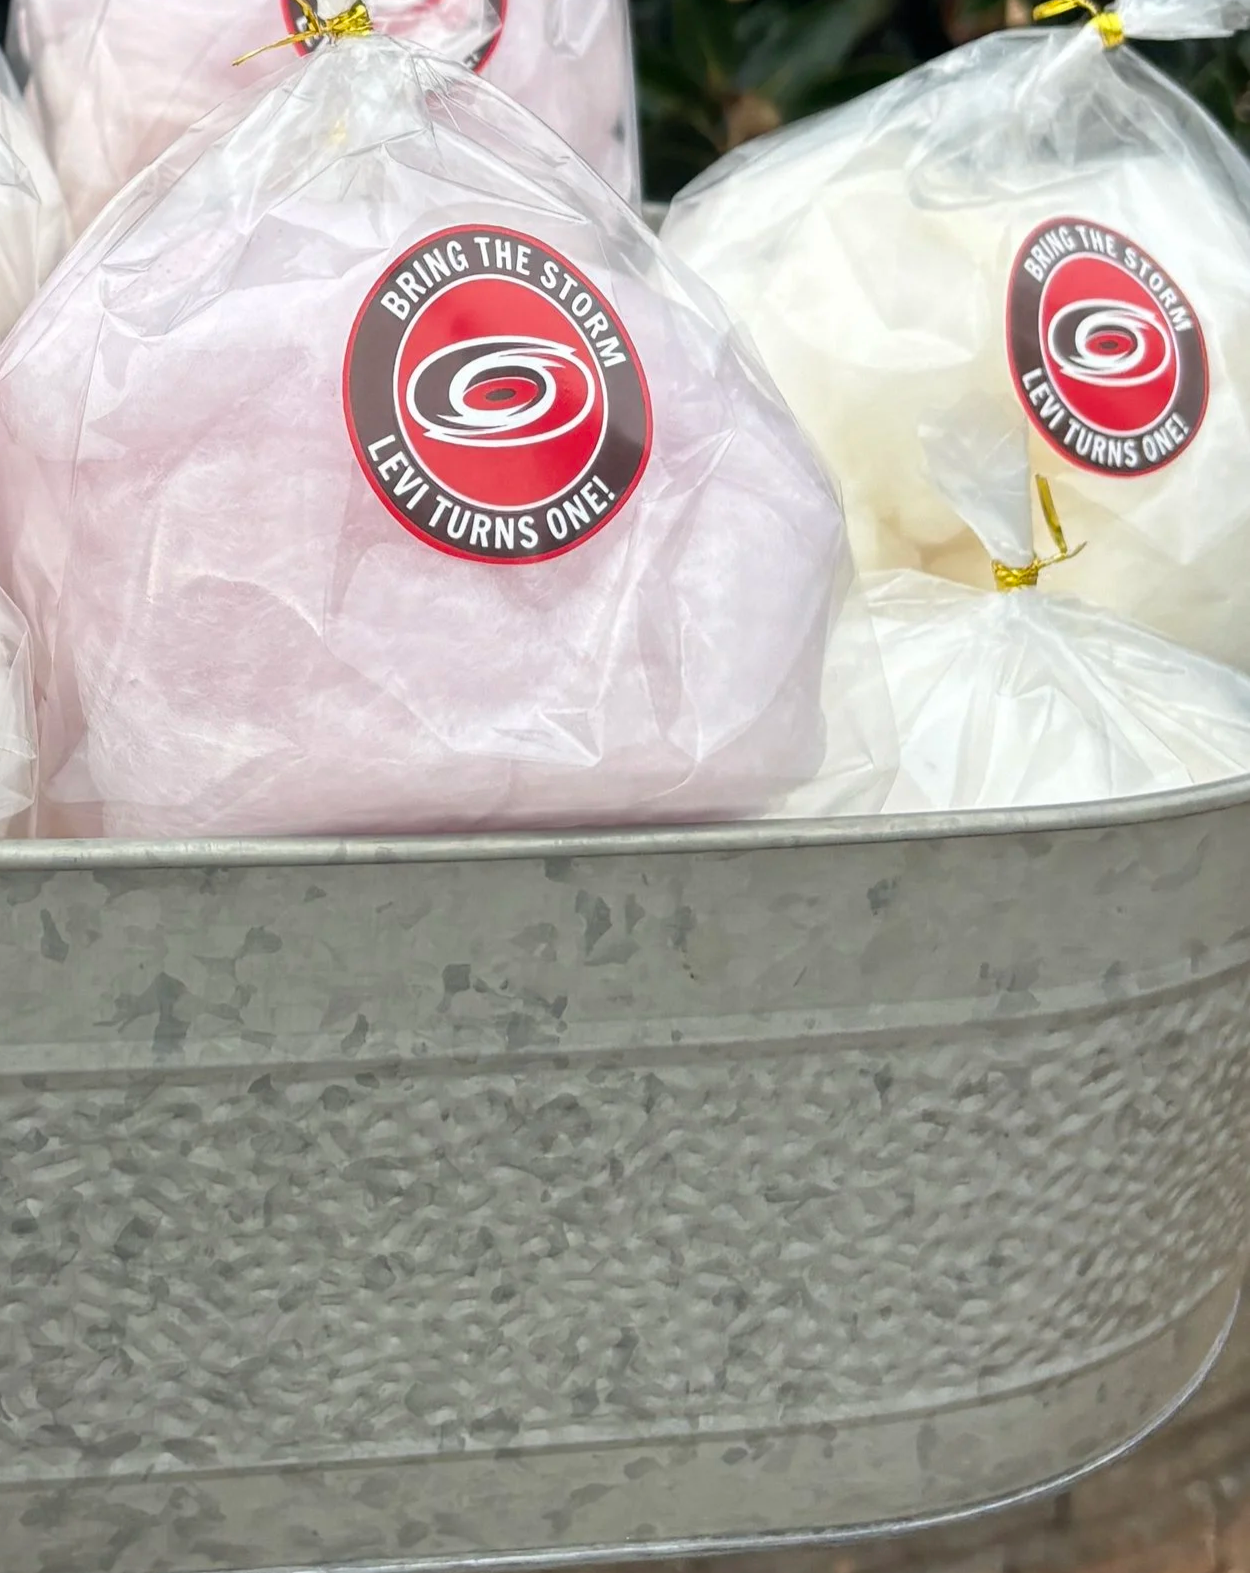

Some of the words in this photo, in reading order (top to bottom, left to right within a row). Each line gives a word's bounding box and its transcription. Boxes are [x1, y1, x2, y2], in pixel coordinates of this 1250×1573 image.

[381, 240, 469, 320] BRING
[474, 237, 531, 275] THE
[540, 261, 626, 368] STORM
[1023, 226, 1075, 283] BRING
[1076, 226, 1118, 258] THE
[1124, 247, 1194, 333] STORM
[1022, 367, 1067, 430] LEVI
[1062, 420, 1137, 468] TURNS
[1142, 412, 1189, 463] ONE!
[368, 434, 429, 510] LEVI
[428, 495, 539, 549] TURNS
[546, 475, 616, 539] ONE!
